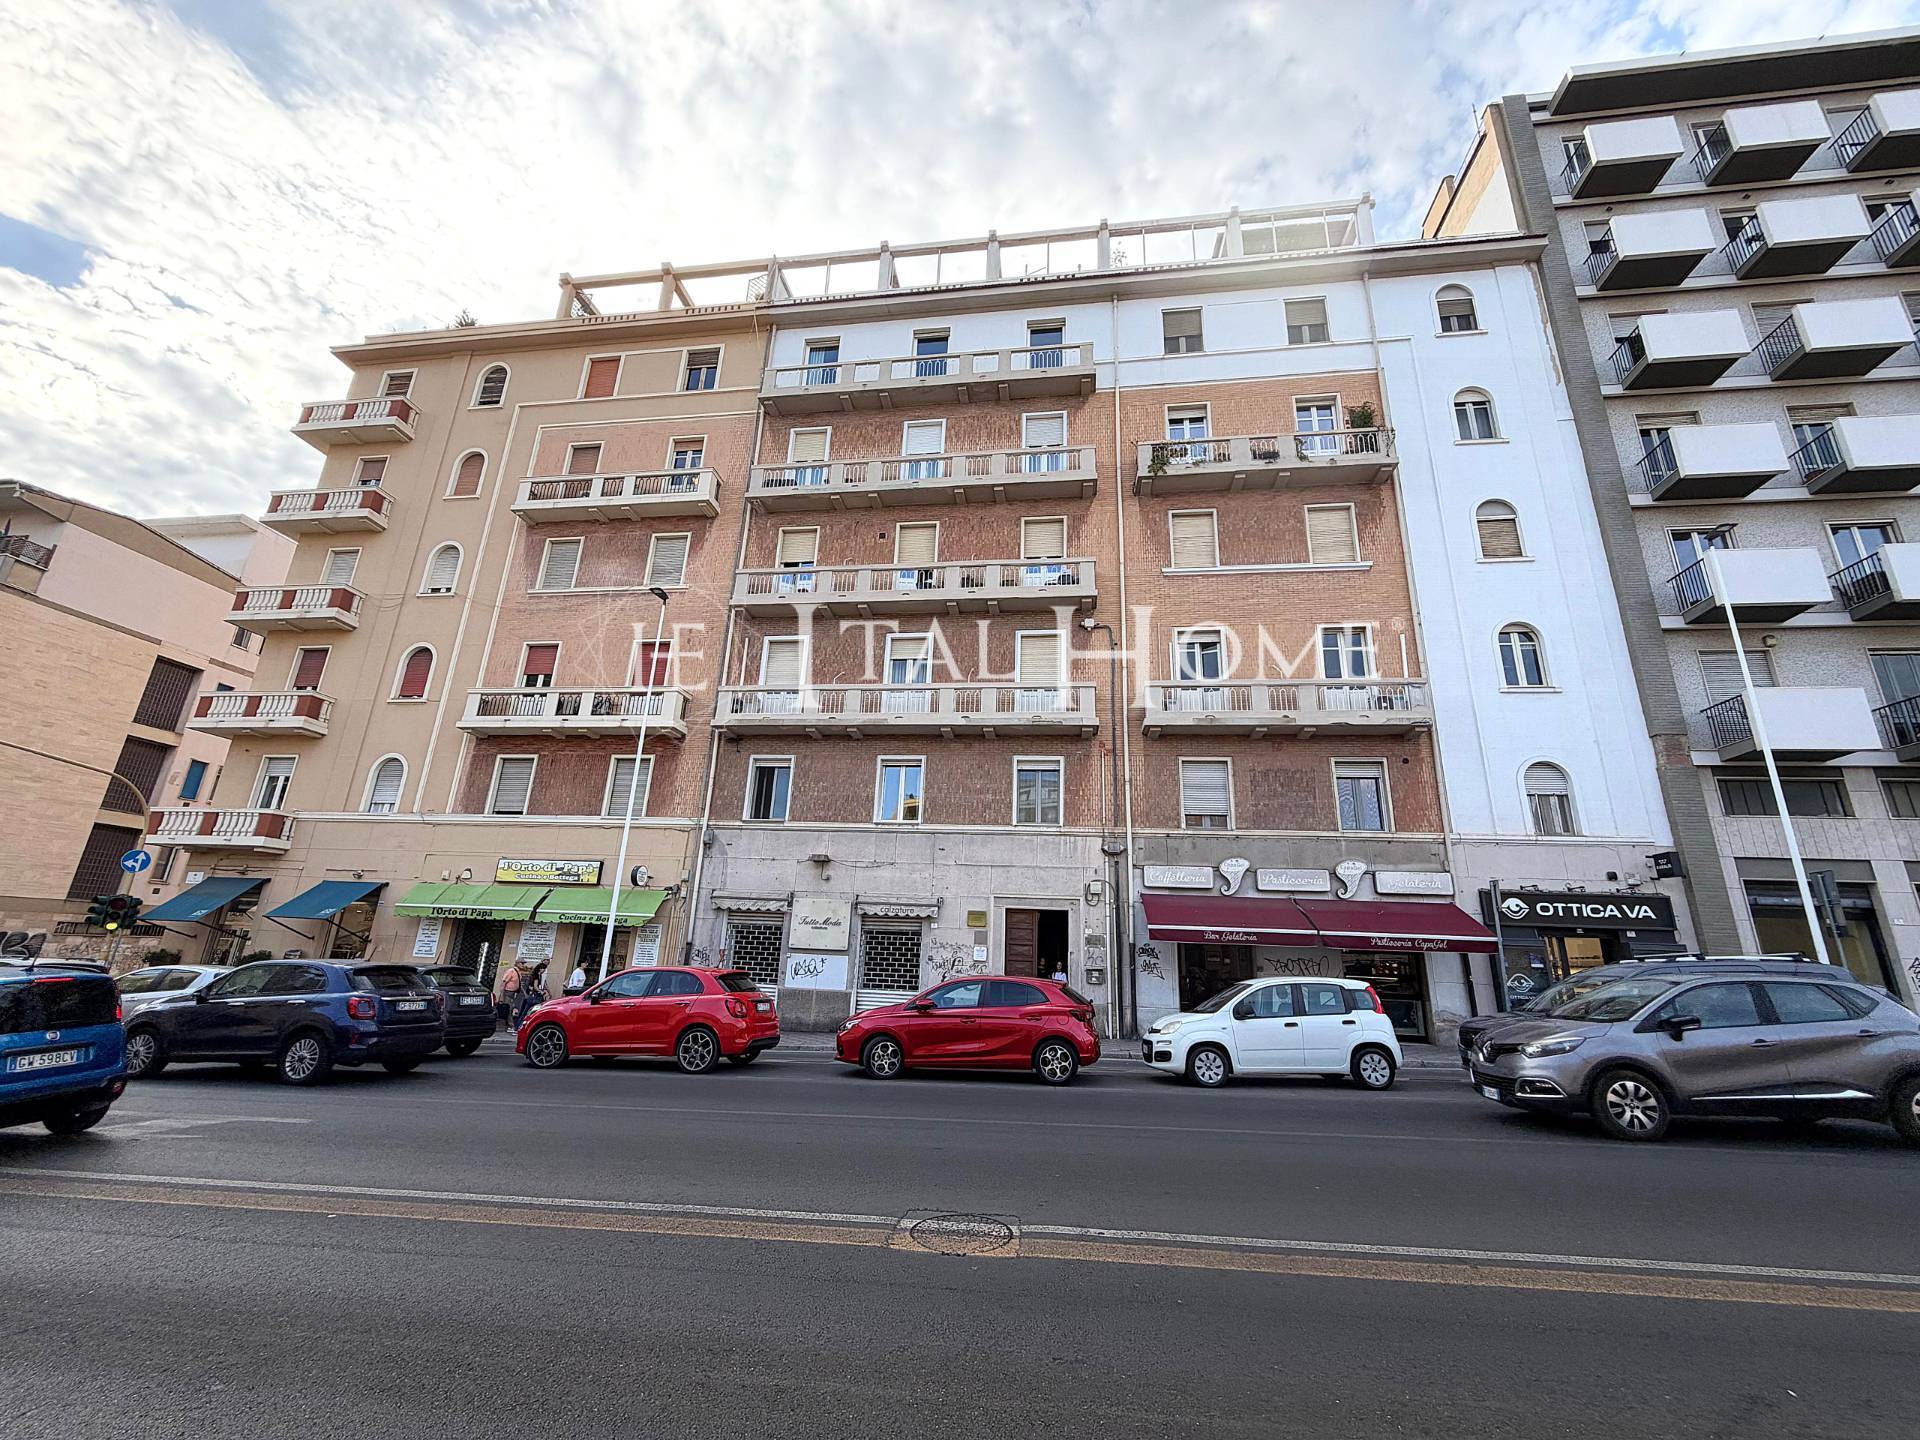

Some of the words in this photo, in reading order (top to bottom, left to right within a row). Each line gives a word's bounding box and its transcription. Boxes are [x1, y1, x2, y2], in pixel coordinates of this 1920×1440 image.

[458, 907, 468, 916] di
[559, 913, 587, 921] Cucina
[1203, 931, 1219, 940] Bar
